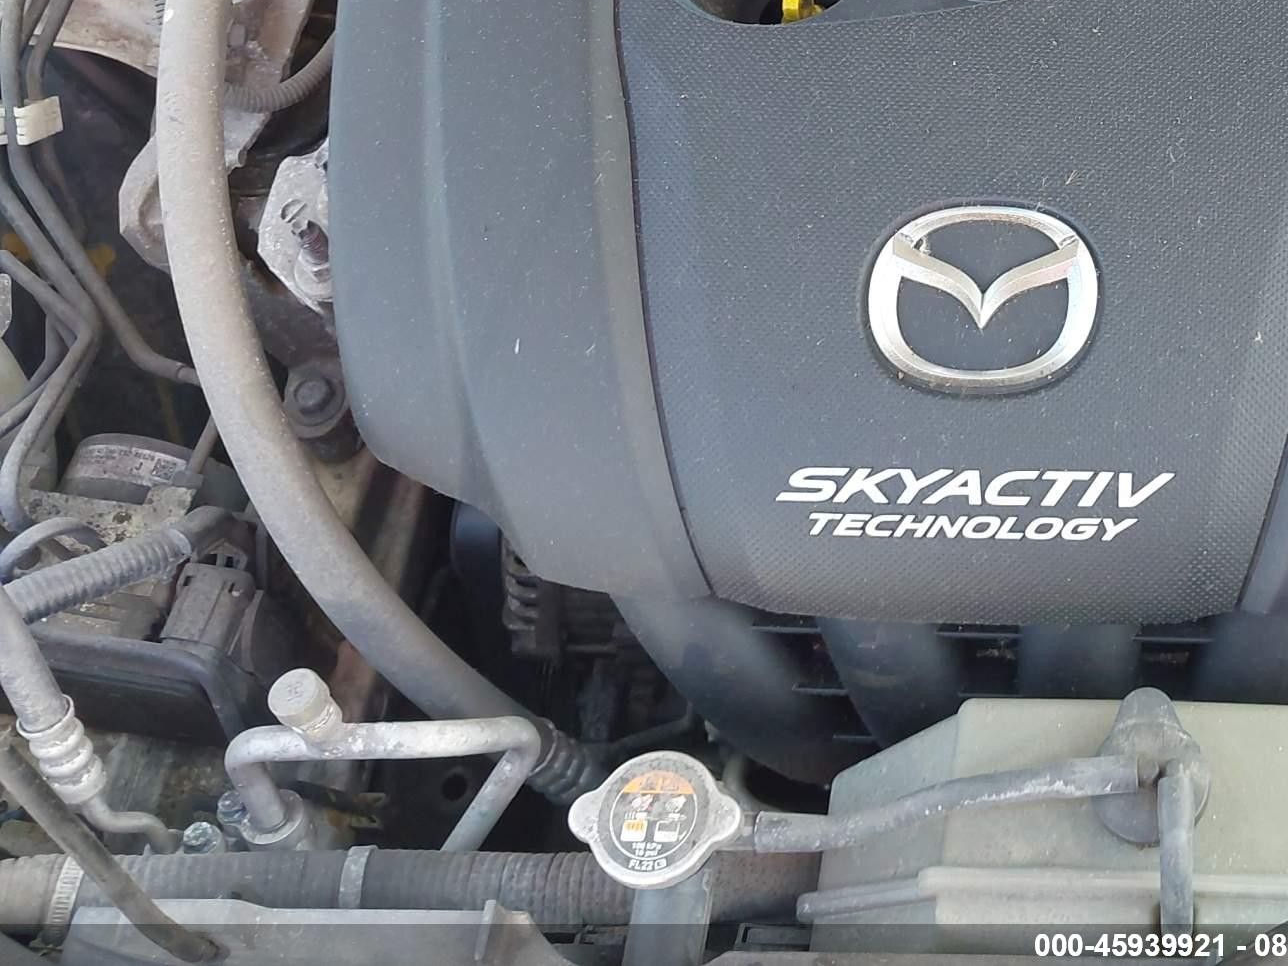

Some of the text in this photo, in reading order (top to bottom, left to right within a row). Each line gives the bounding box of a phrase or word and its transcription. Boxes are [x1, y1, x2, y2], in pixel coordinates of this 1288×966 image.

[776, 466, 1177, 509] SKYACTIV
[808, 512, 1139, 542] TECHNOLOGY
[628, 858, 654, 871] FL22
